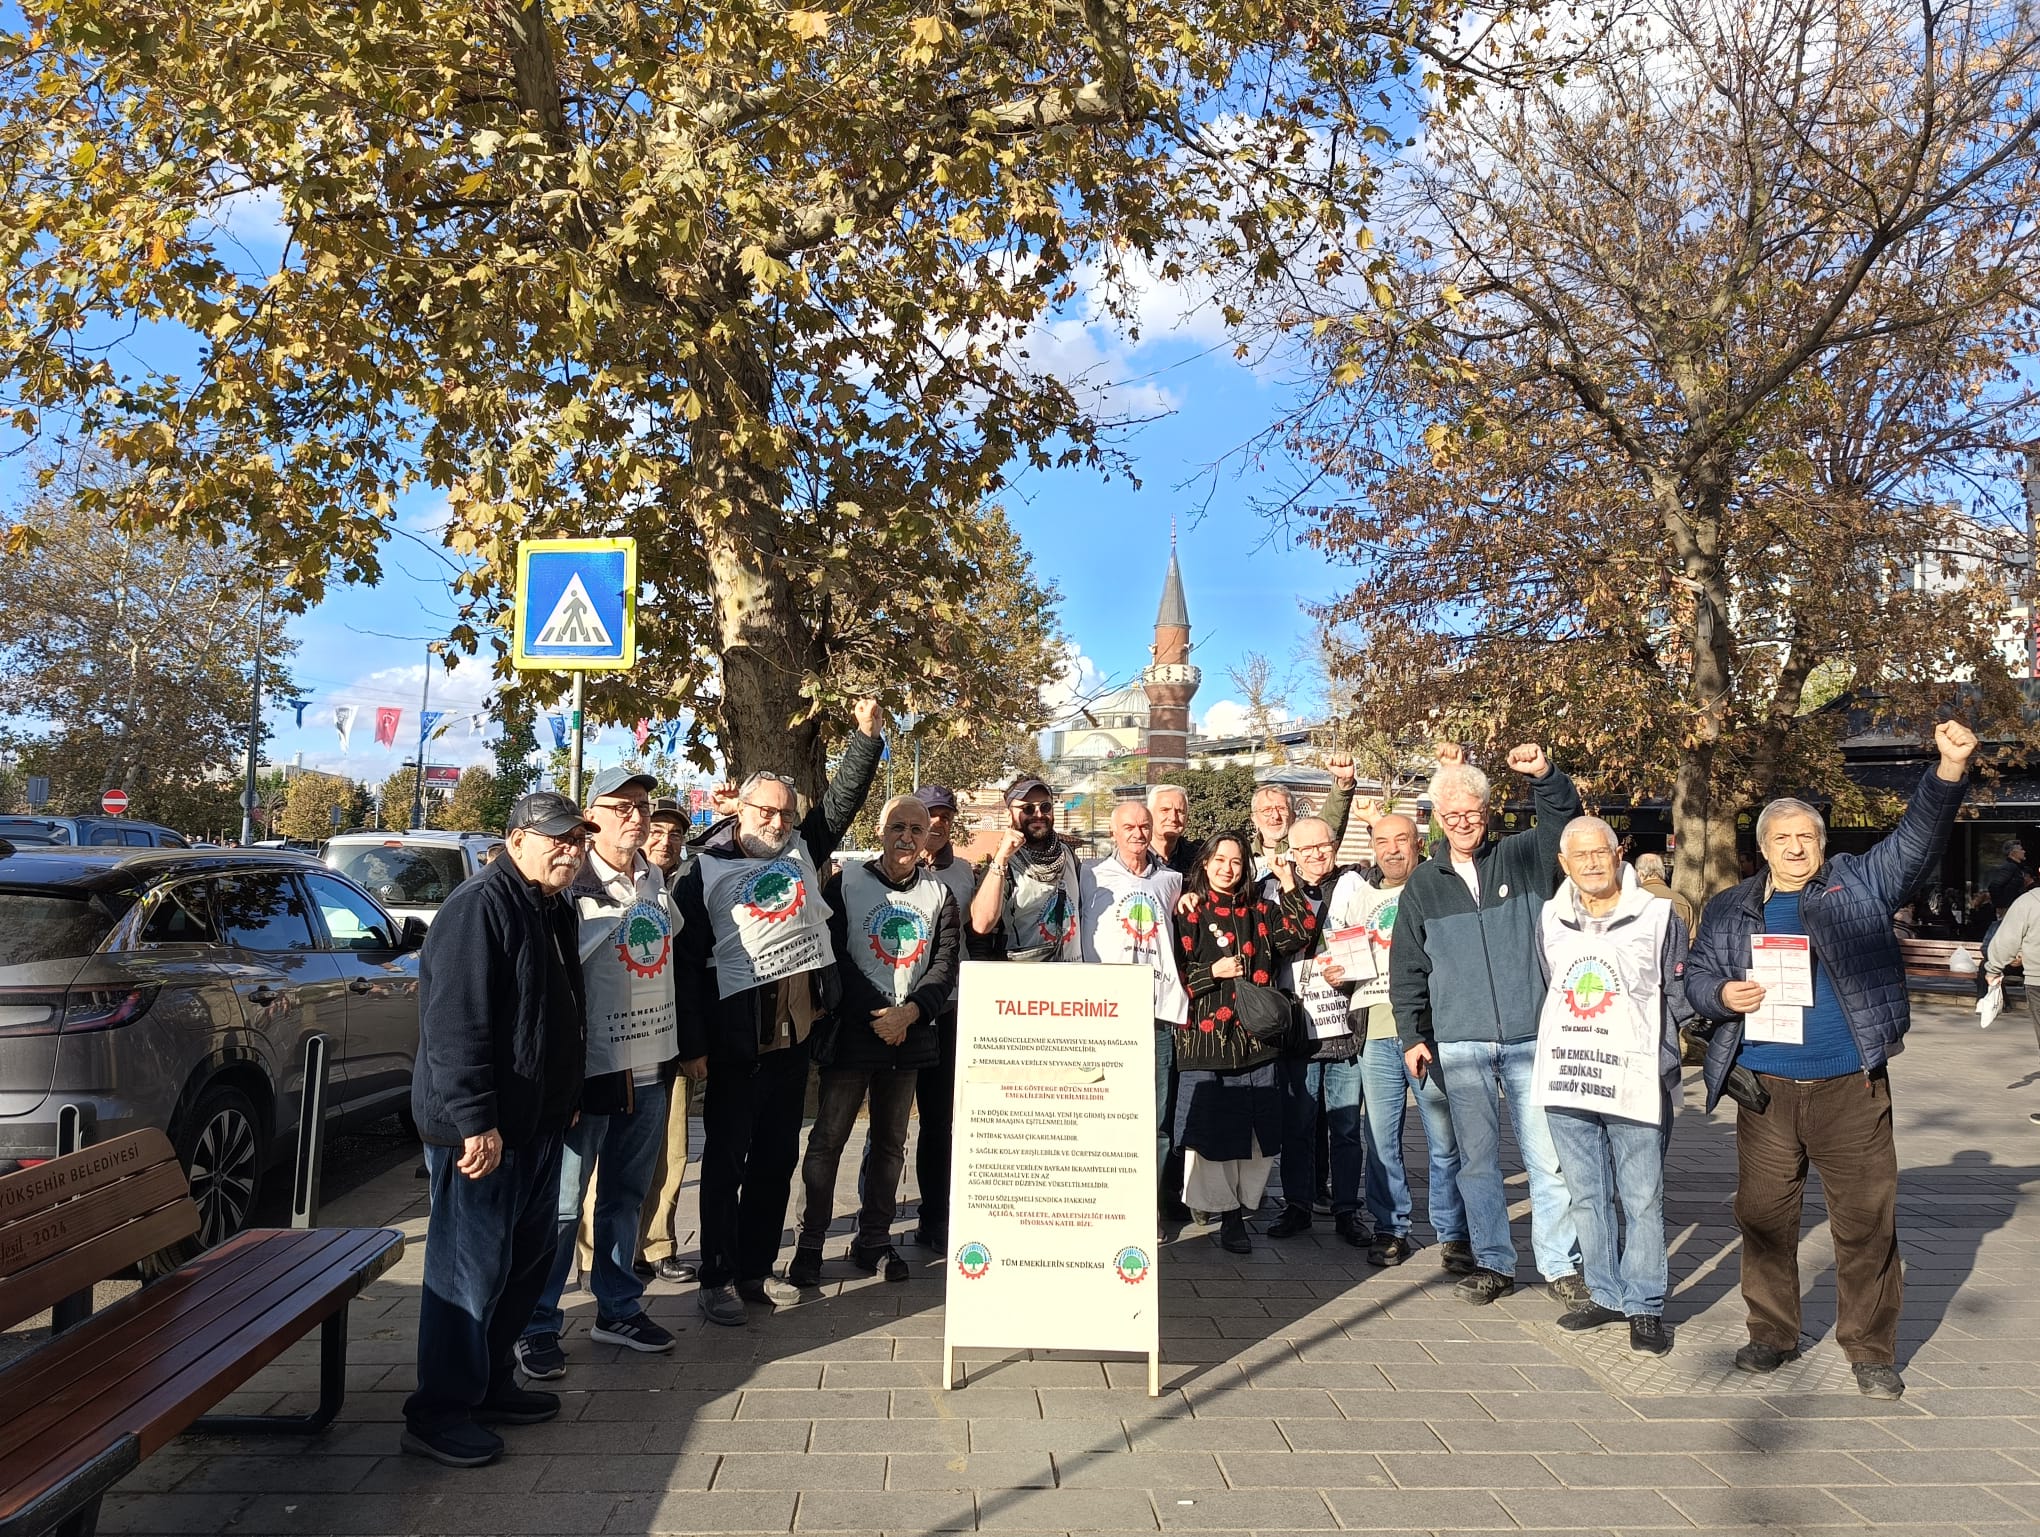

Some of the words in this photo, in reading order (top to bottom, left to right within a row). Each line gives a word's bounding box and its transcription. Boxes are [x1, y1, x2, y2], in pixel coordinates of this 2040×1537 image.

[752, 966, 791, 983] İSTANBUL
[995, 998, 1119, 1018] TALEPLERİMİZ
[980, 1036, 998, 1044] MAAŞ
[1107, 1038, 1138, 1046] BAĞLAMA
[1551, 1046, 1566, 1060] TÜM
[1559, 1063, 1602, 1080] SENDİKASI
[1024, 1084, 1057, 1092] GÖSTERGE
[1580, 1082, 1616, 1099] ŞUBESİ
[987, 1109, 1009, 1117] DÜŞÜK
[1073, 1111, 1083, 1119] İŞE
[1083, 1112, 1106, 1120] GİRMİŞ
[1116, 1112, 1139, 1120] DÜŞÜK
[995, 1117, 1025, 1125] MAAŞINA
[70, 1142, 139, 1182] BELEDİYESİ
[1071, 1165, 1117, 1173] İKRAMİYELERİ
[993, 1178, 1014, 1186] ÜCRET
[1014, 1179, 1048, 1187] DÜZEYİNE
[995, 1194, 1034, 1203] SÖZLEŞMELİ
[1051, 1212, 1104, 1220] ADALETSİZLİĞE
[1001, 1258, 1018, 1267] TÜM
[1065, 1260, 1105, 1269] SENDİKASI
